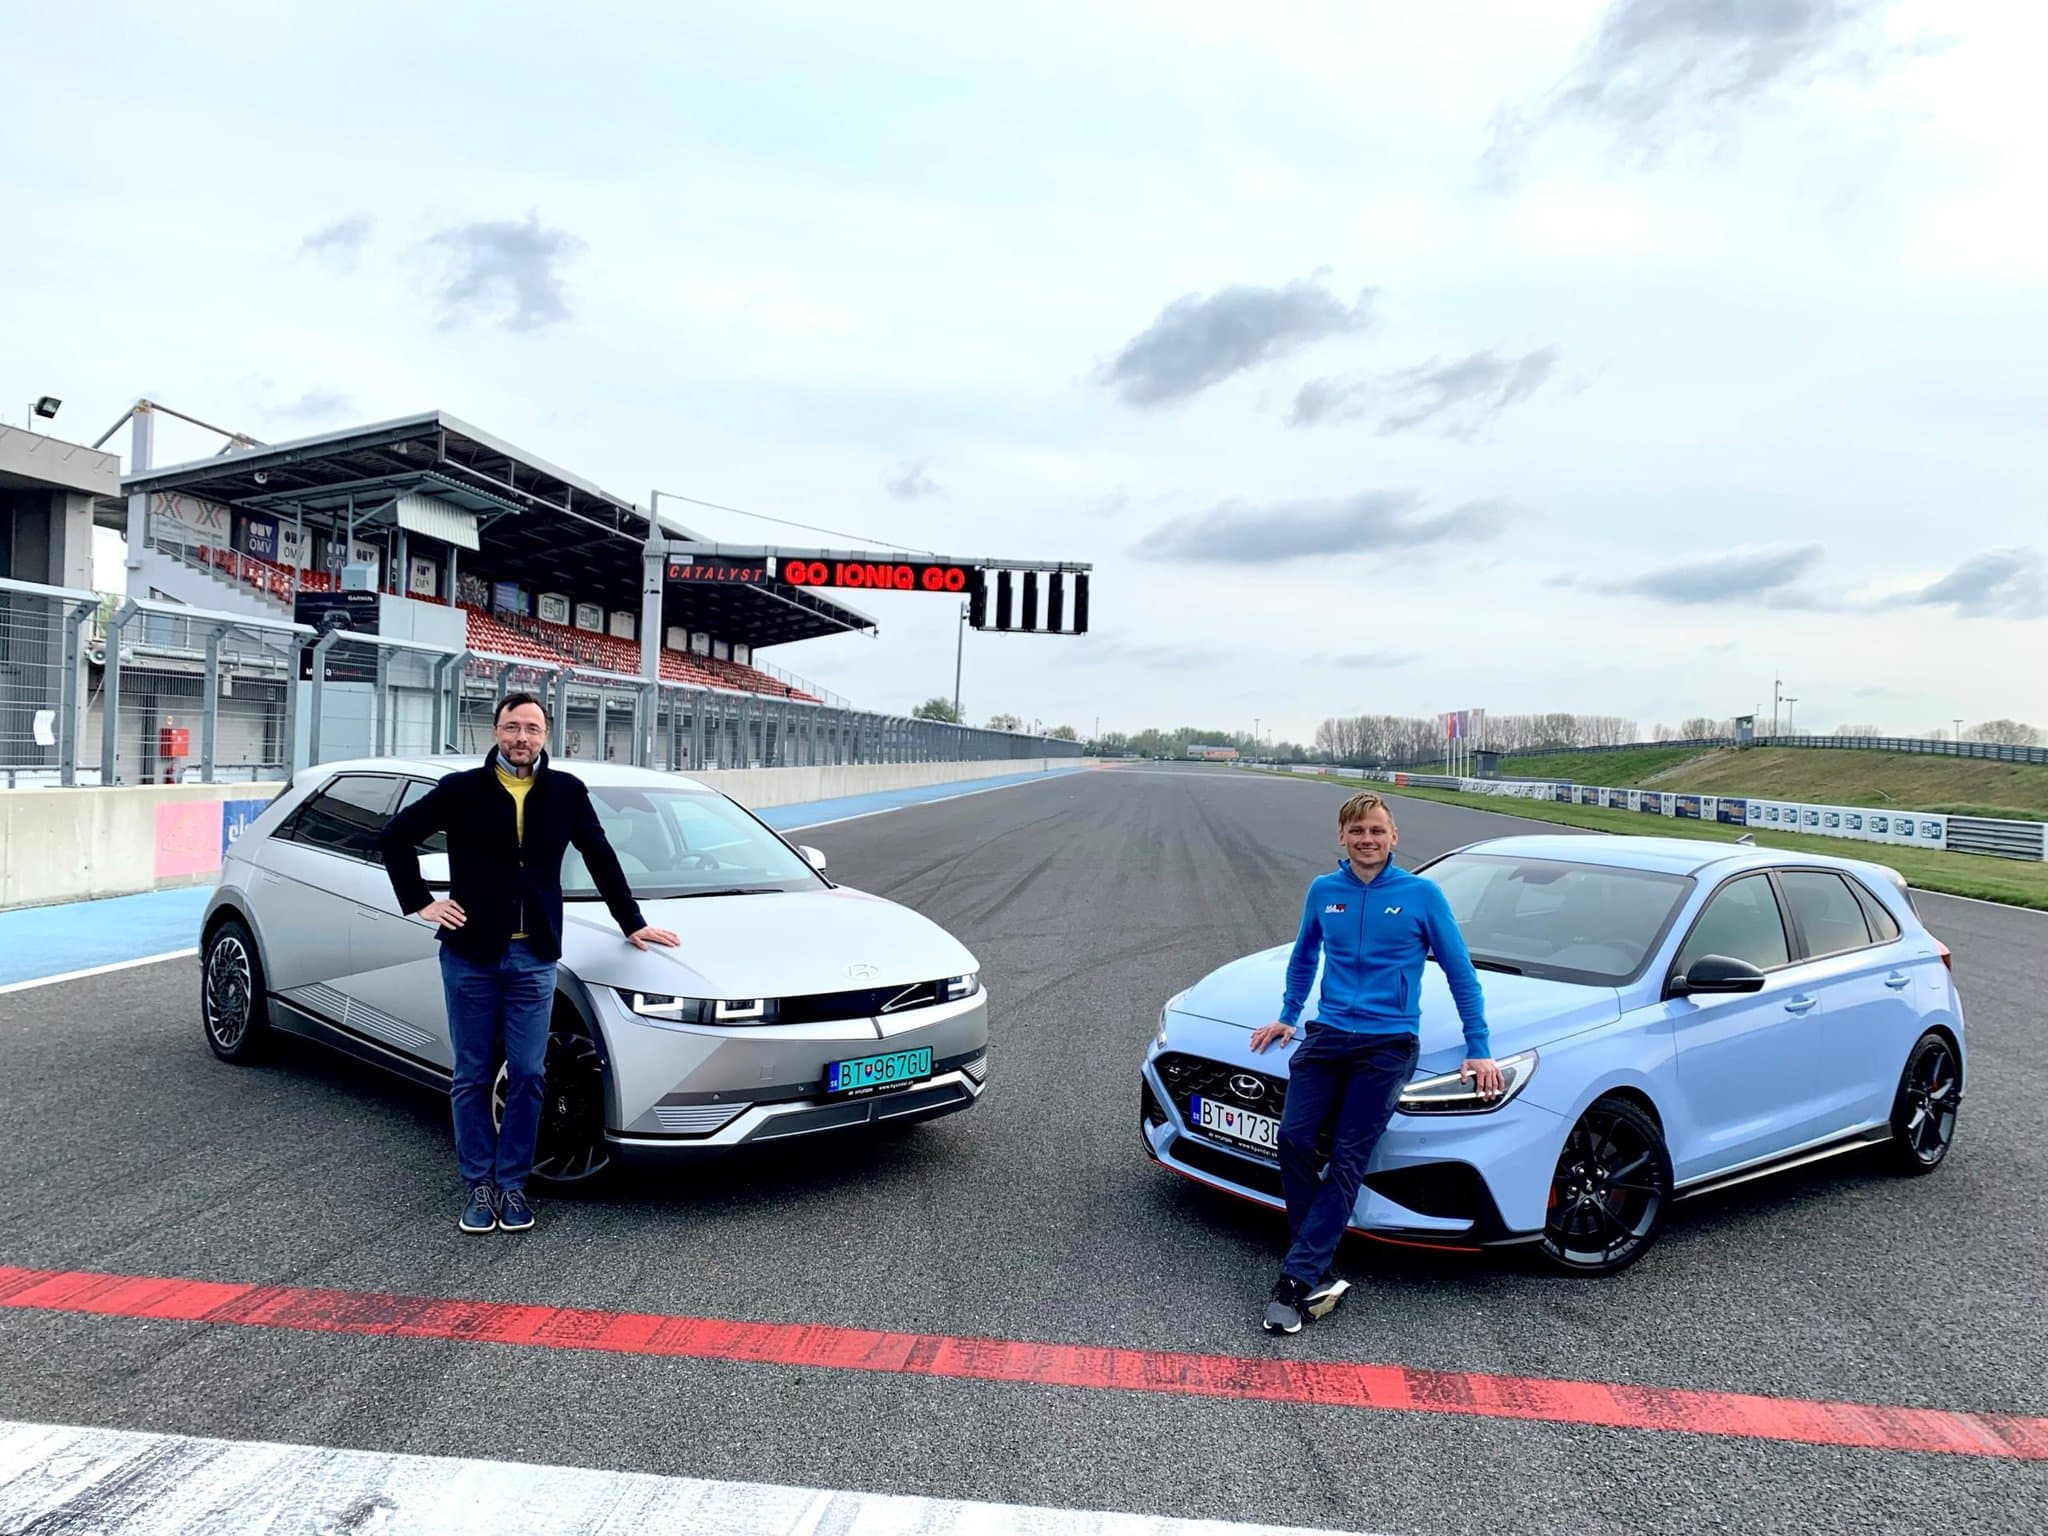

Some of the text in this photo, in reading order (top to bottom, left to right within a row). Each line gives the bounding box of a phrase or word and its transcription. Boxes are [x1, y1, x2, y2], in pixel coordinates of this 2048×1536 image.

[249, 538, 272, 553] OMV
[669, 564, 764, 582] CATALYST
[785, 560, 966, 592] GO IONIQ GO
[841, 1051, 929, 1087] BT 967GU
[1203, 1101, 1225, 1129] BT
